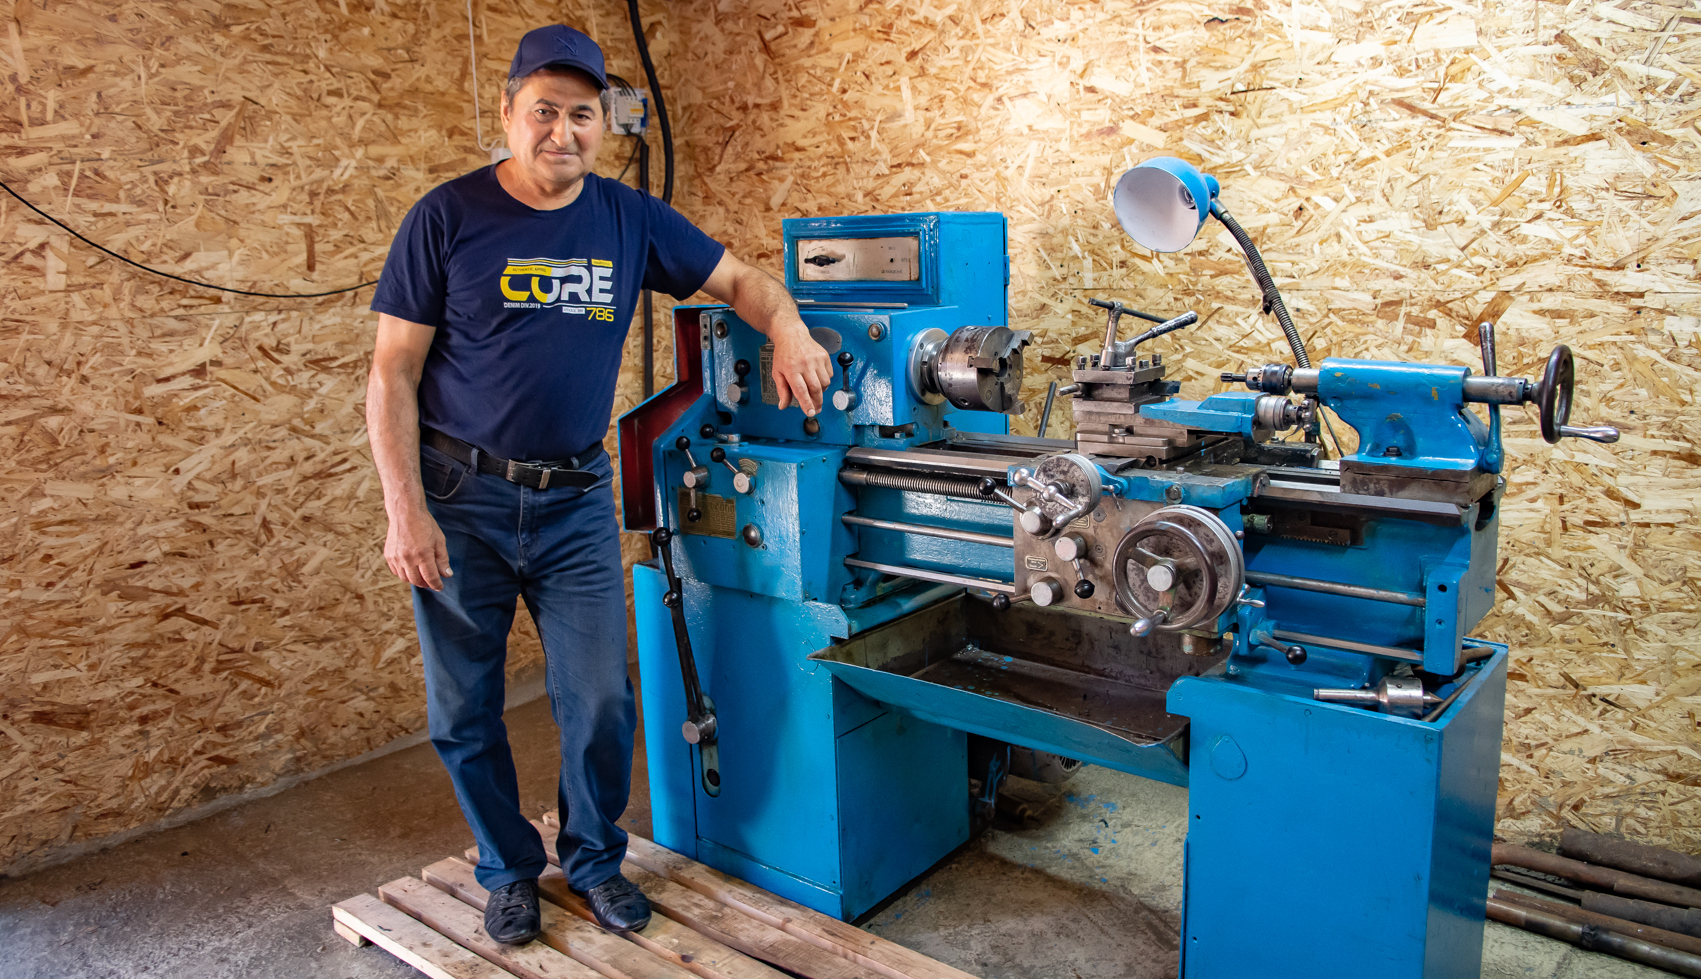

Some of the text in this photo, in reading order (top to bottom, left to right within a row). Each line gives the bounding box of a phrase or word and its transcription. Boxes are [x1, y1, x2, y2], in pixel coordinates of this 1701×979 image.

[500, 265, 614, 303] CORE
[503, 301, 520, 309] DENIM
[586, 307, 614, 322] 786
